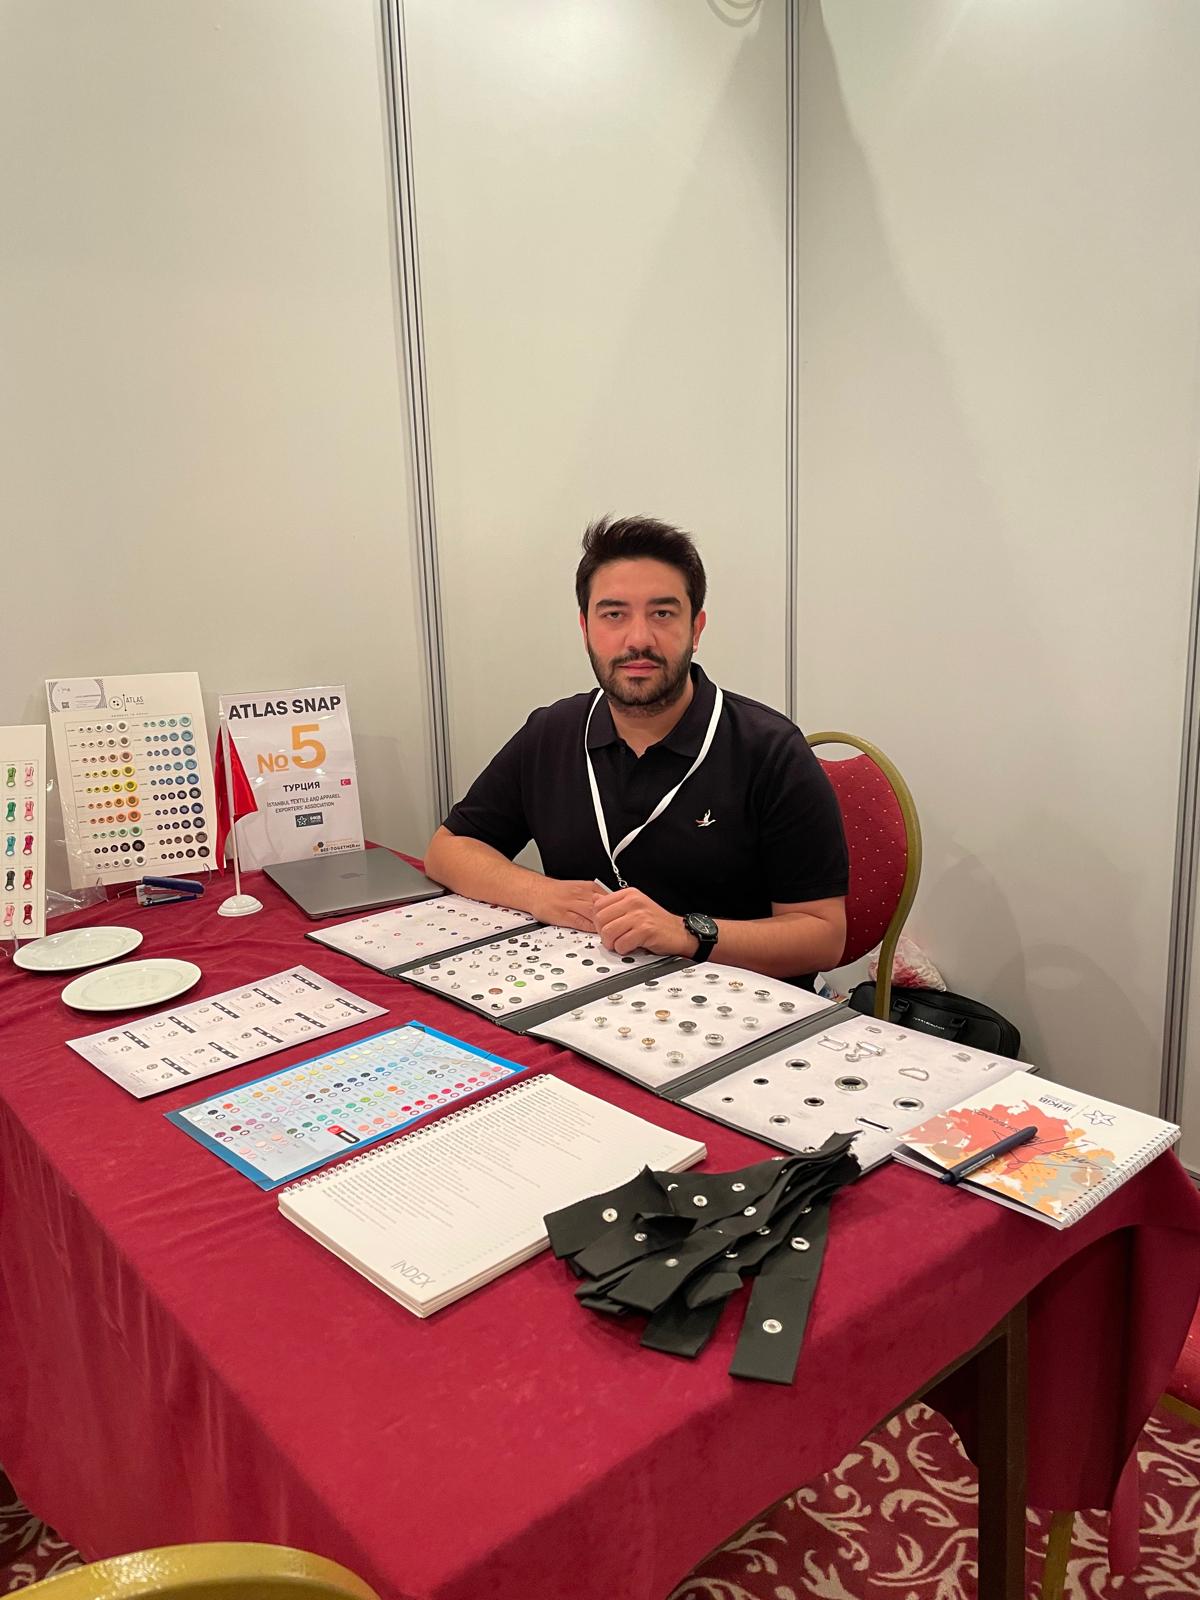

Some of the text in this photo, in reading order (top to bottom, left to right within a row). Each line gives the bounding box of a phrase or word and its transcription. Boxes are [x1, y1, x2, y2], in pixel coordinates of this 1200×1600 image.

[228, 696, 341, 720] ATLAS SNAP
[291, 724, 326, 769] 5
[283, 781, 320, 792] ТУРЦИЯ
[290, 797, 309, 805] TEXTILE
[304, 802, 334, 810] ASSOCIATION
[391, 1260, 436, 1288] INDEX
